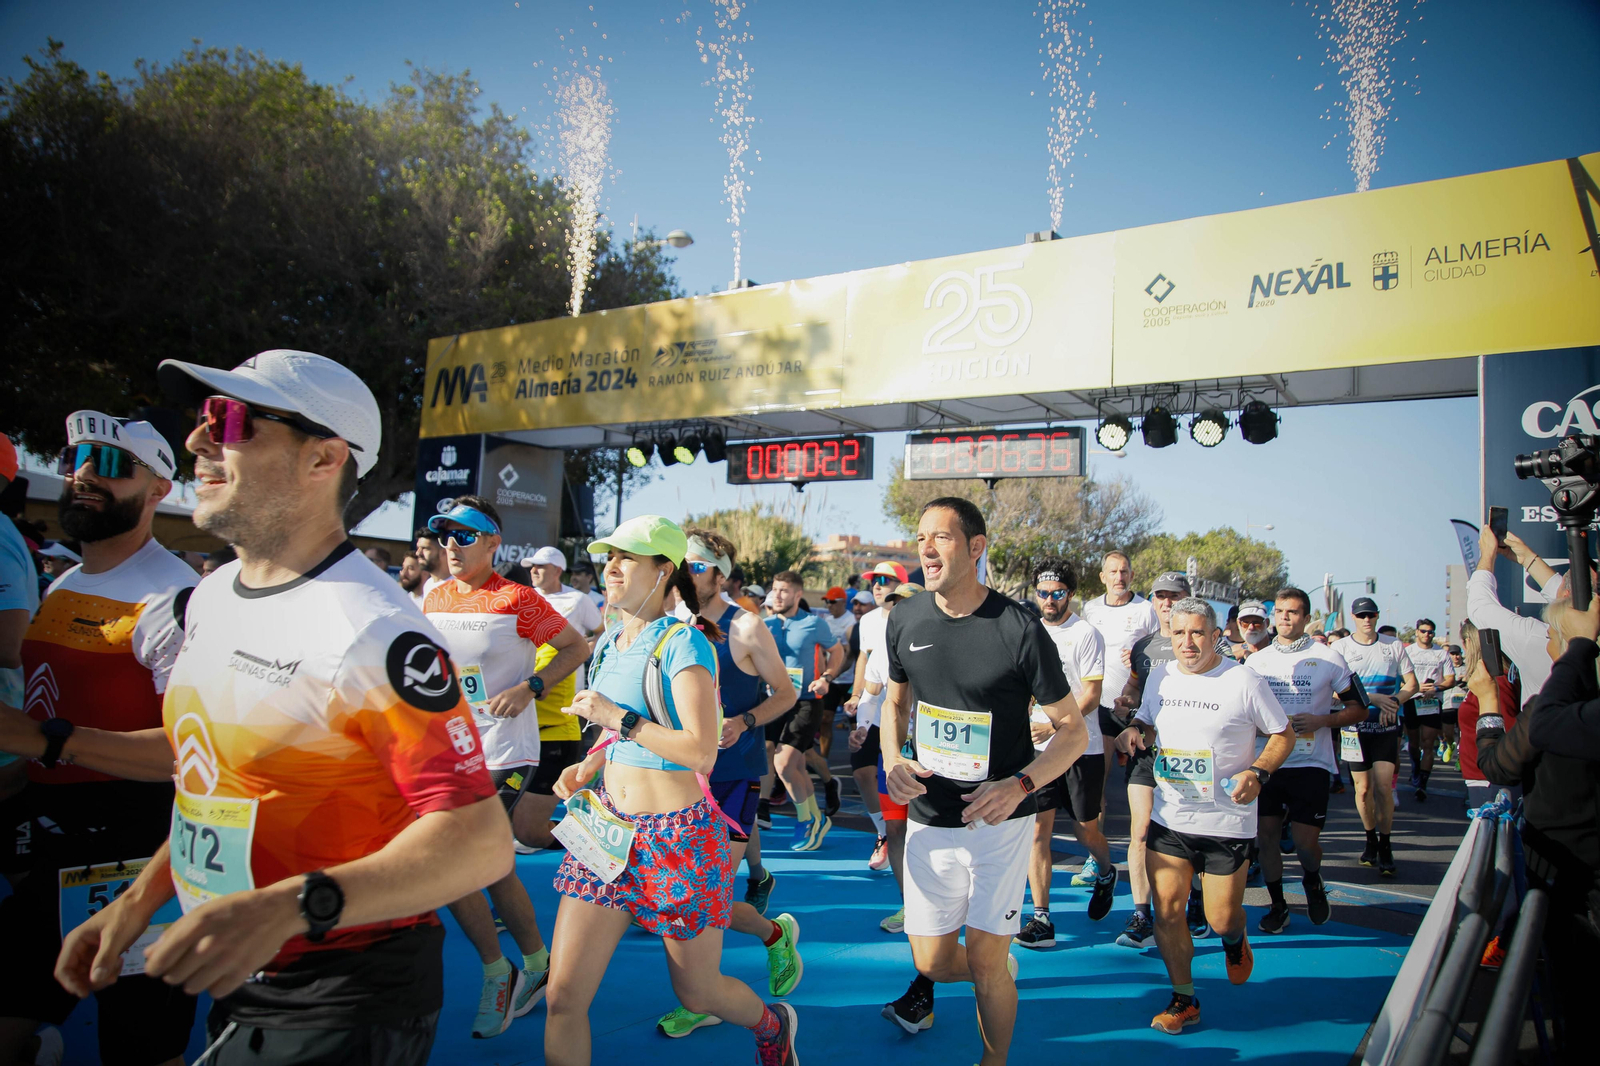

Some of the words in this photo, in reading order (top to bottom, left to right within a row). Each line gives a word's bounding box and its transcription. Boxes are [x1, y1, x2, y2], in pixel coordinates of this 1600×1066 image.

[1425, 229, 1551, 266] ALMERÍA
[1424, 264, 1487, 282] CIUDAD
[922, 261, 1033, 355] 25
[1143, 299, 1227, 318] COOPERACIÓN
[1255, 299, 1276, 308] 2020
[1143, 318, 1171, 328] 2005
[517, 356, 563, 375] Medio
[569, 346, 640, 369] Maratón
[515, 373, 581, 399] Almería
[585, 367, 638, 392] 2024
[648, 370, 694, 387] RAMÓN
[699, 368, 730, 382] RUIZ
[735, 360, 802, 379] ANDÚJAR
[425, 466, 471, 486] cajamar
[496, 488, 548, 503] COOPERACIÓN
[493, 543, 541, 566] NEXA
[266, 671, 291, 688] CAR
[1159, 698, 1220, 711] COSENTINO
[930, 719, 971, 745] 191
[939, 742, 960, 750] JORGE
[1160, 756, 1207, 774] 1226
[16, 821, 31, 854] FILA
